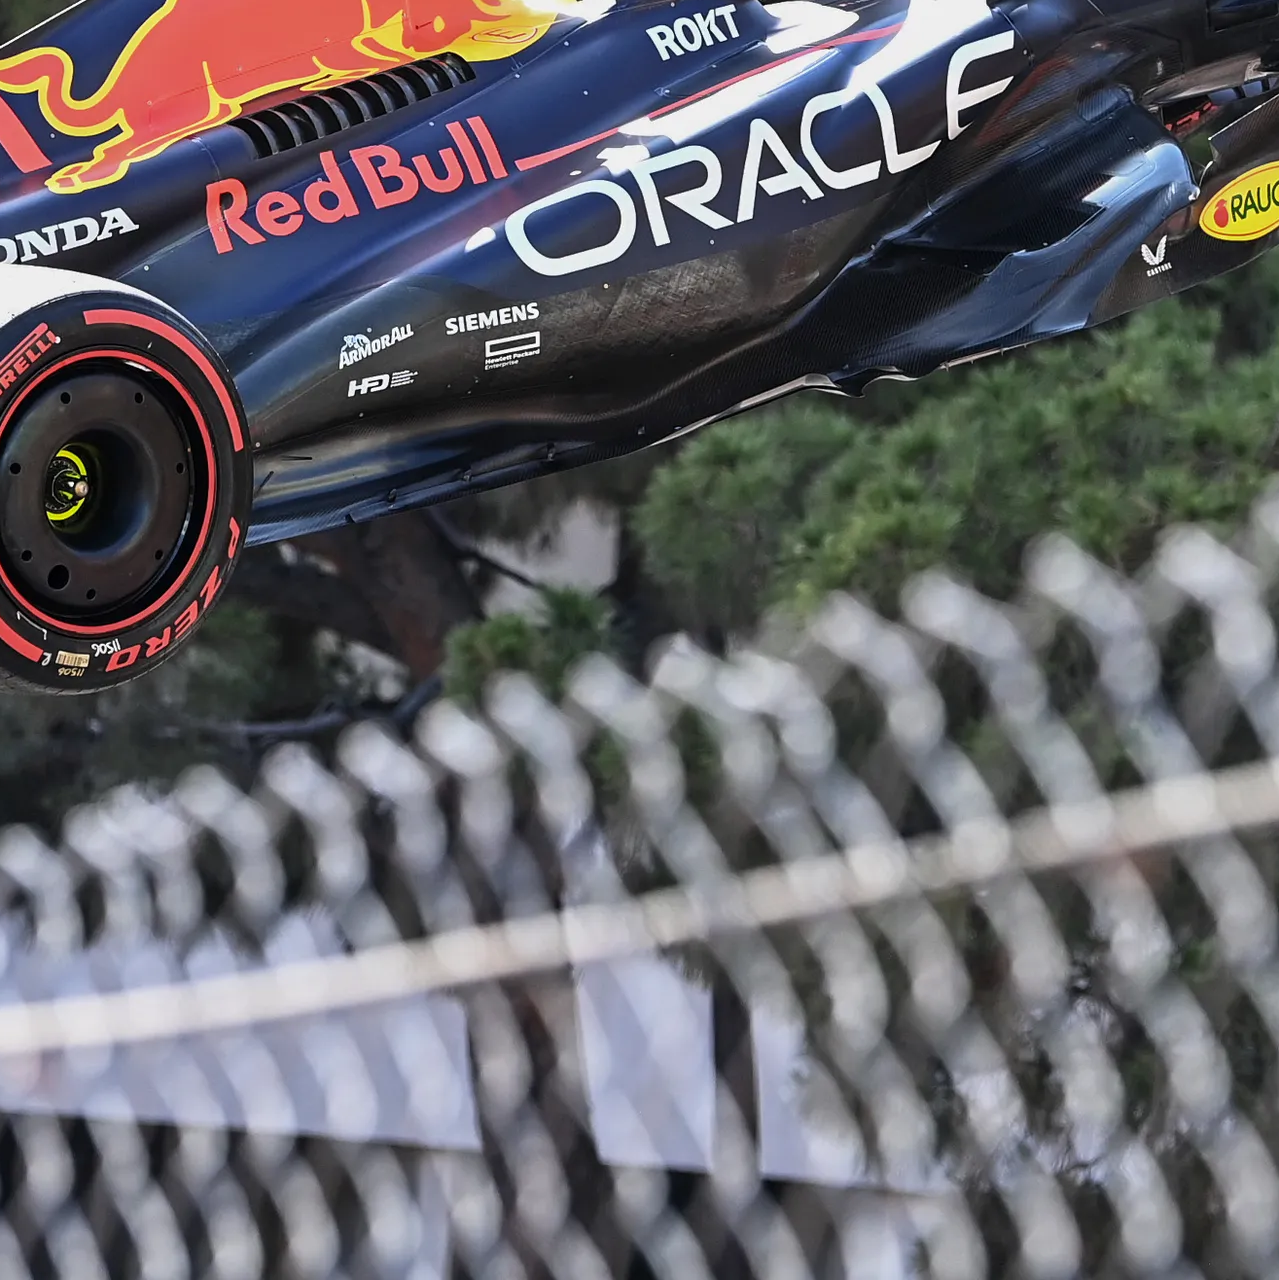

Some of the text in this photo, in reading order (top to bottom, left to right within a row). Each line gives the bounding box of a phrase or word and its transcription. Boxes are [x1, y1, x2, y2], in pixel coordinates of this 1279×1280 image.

[645, 3, 740, 62] ROKT
[504, 29, 1016, 277] ORACLE
[205, 115, 509, 255] Red Bull
[444, 301, 540, 336] SIEMENS
[484, 359, 520, 371] Enterprise
[485, 348, 541, 366] Hewlett Packard
[104, 516, 240, 673] P ZERO
